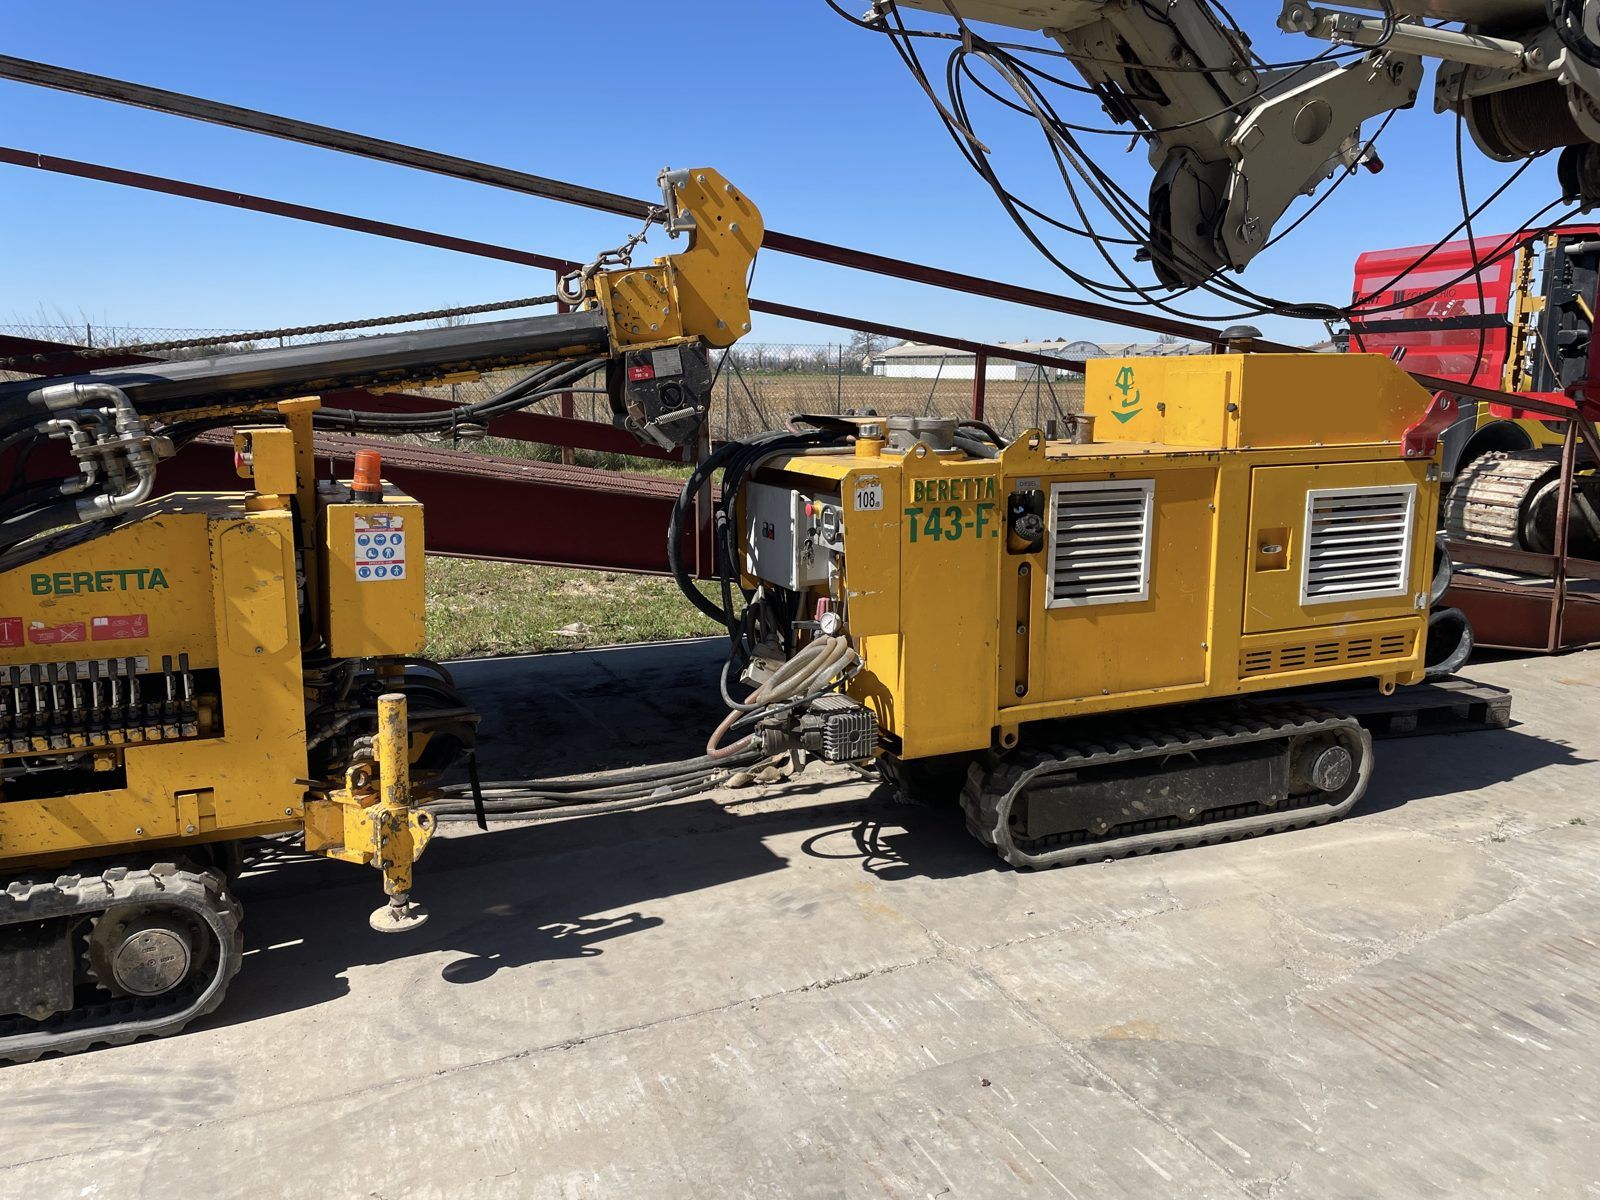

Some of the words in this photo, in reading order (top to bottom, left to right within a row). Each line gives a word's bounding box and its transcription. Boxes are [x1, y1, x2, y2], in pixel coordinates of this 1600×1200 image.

[858, 491, 875, 508] 108
[914, 478, 994, 502] BERETTA
[904, 502, 999, 543] T43-F.
[30, 568, 169, 595] BERETTA
